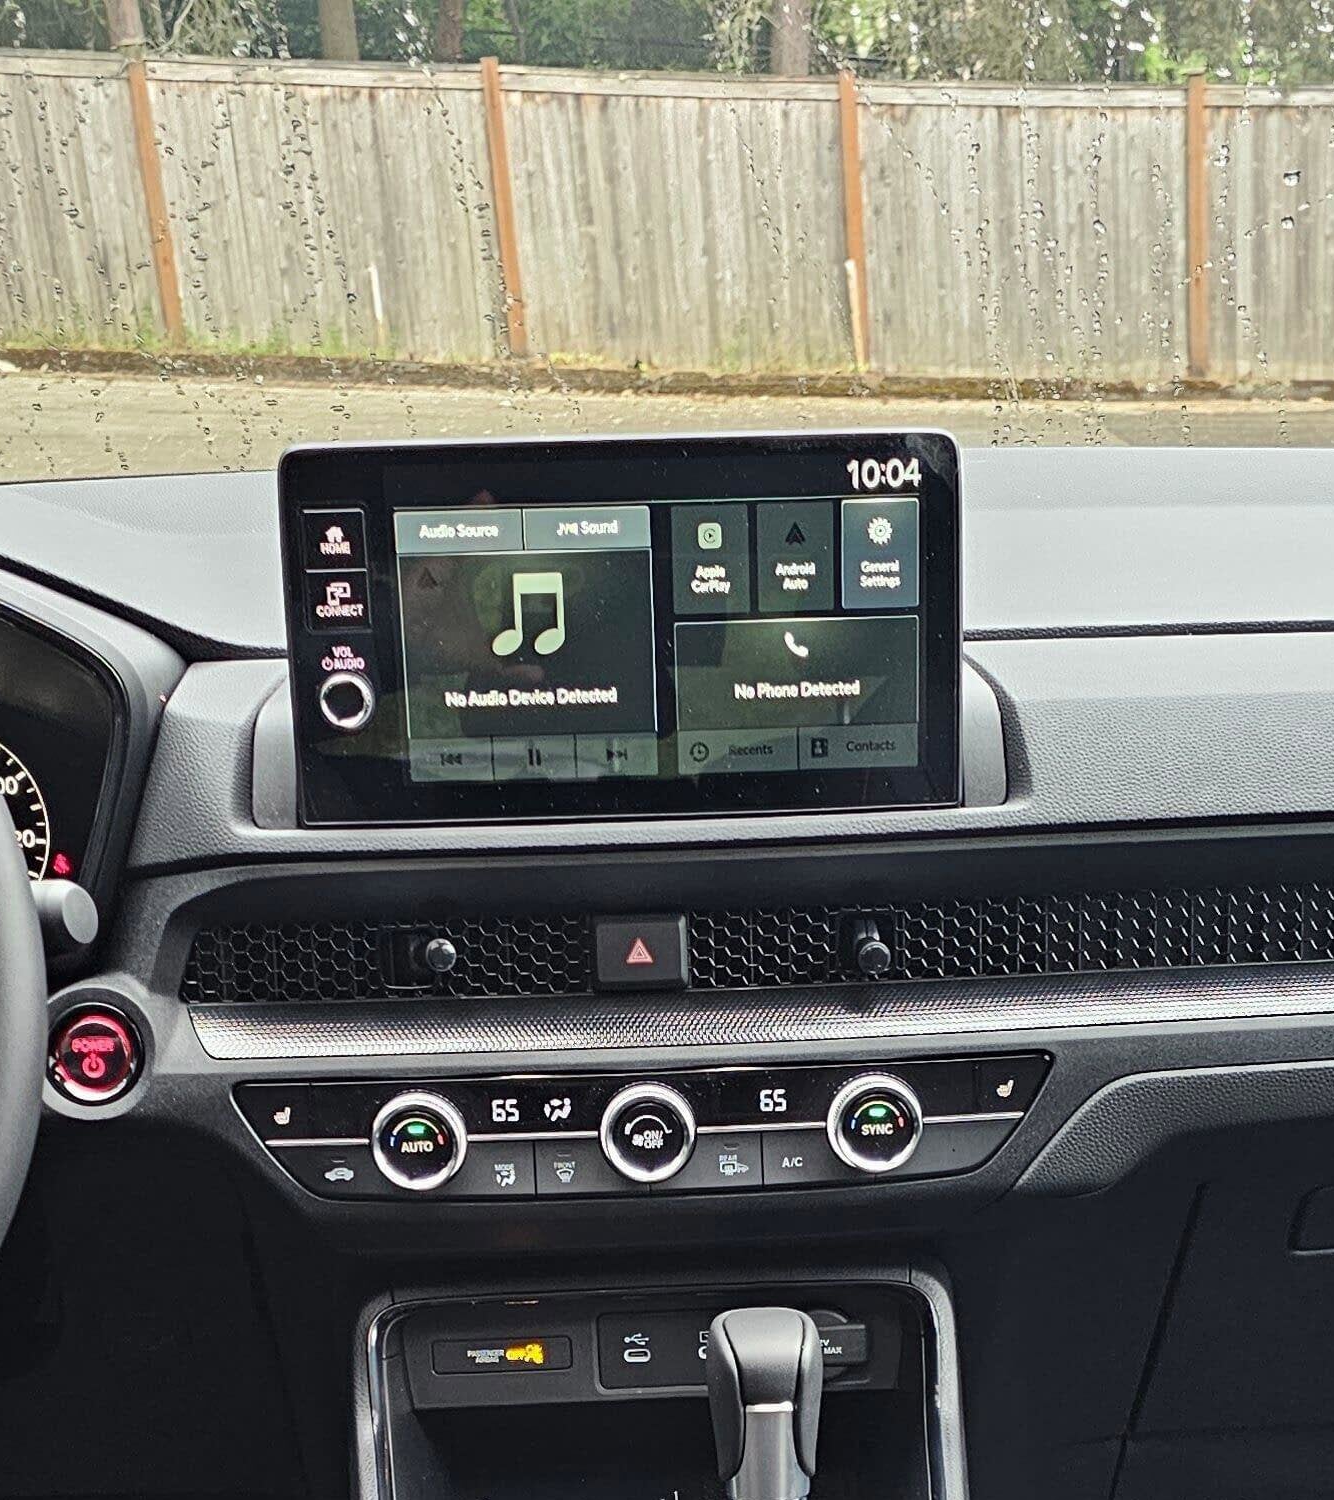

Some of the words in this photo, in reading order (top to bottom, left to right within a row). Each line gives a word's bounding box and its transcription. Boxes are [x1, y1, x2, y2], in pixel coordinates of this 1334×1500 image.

[847, 457, 922, 490] 10:04
[419, 524, 456, 539] Audio
[456, 523, 499, 538] Source
[580, 519, 618, 535] Sound
[319, 541, 351, 555] HOME
[695, 565, 726, 580] Apple
[775, 562, 816, 577] Android
[859, 559, 900, 574] General
[782, 578, 809, 591] Auto
[859, 574, 901, 589] Settings
[315, 604, 364, 618] CONNECT
[331, 646, 354, 658] VOL
[334, 657, 365, 671] AUDIO
[444, 691, 466, 708] No
[468, 690, 508, 707] Audio
[508, 689, 555, 706] Device
[556, 686, 618, 705] Detected
[734, 683, 755, 700] No
[756, 682, 799, 699] Phone
[800, 680, 861, 698] Detected
[728, 744, 773, 757] Recents
[846, 740, 896, 753] Contacts
[759, 1088, 788, 1113] 65
[491, 1098, 520, 1123] 65
[860, 1123, 895, 1137] SYNC
[400, 1141, 434, 1155] AUTO
[781, 1155, 804, 1169] A/C
[823, 1347, 843, 1355] MAX
